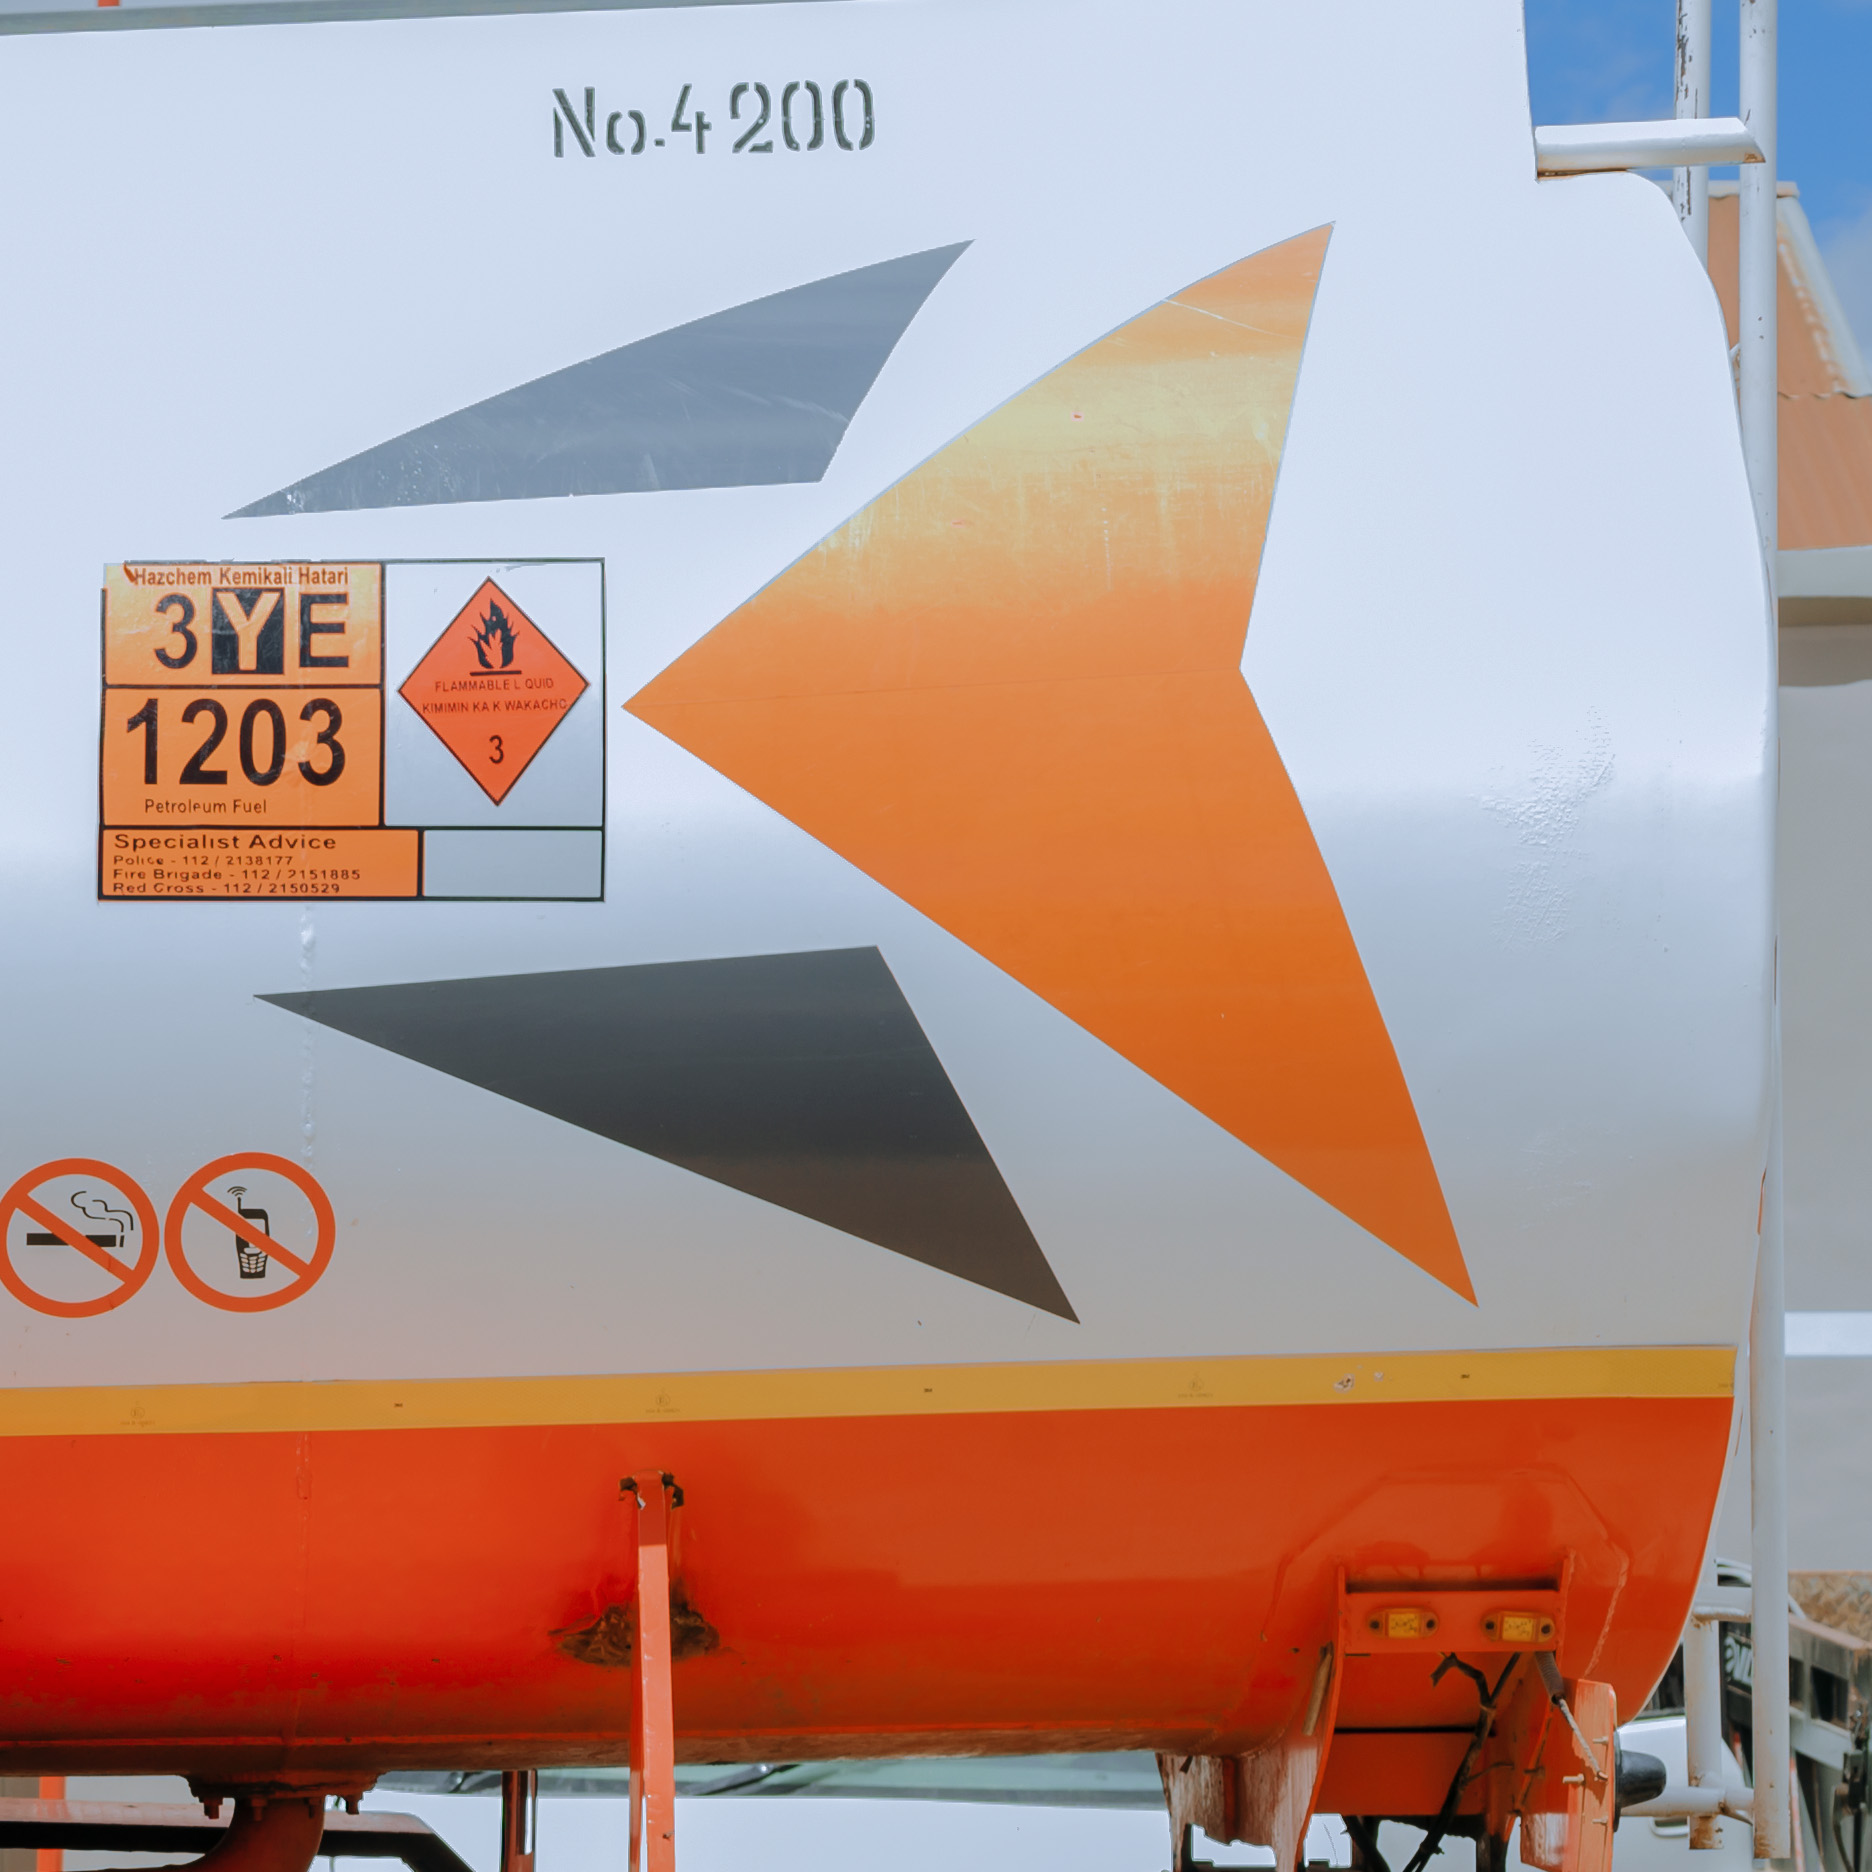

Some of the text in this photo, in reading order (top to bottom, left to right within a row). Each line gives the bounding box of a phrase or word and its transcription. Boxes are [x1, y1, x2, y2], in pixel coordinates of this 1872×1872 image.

[552, 79, 876, 158] No.4200
[134, 566, 349, 586] Hazchem Kemikali Hatari
[435, 679, 510, 693] FLAMMABLE
[126, 697, 346, 786] 1203
[489, 735, 505, 764] 3
[144, 798, 267, 814] Petroleum Fuel
[114, 833, 337, 852] Specialist Advice
[113, 855, 164, 866] Police
[183, 855, 210, 866] 112
[226, 855, 294, 866] 2138177
[113, 869, 146, 880] Fire
[154, 868, 223, 882] Brigade
[243, 869, 270, 880] 112
[288, 869, 361, 880] 2151885
[113, 882, 147, 894] Red
[153, 882, 204, 894] Cross
[224, 882, 252, 894] 112
[269, 882, 340, 894] 2150529
